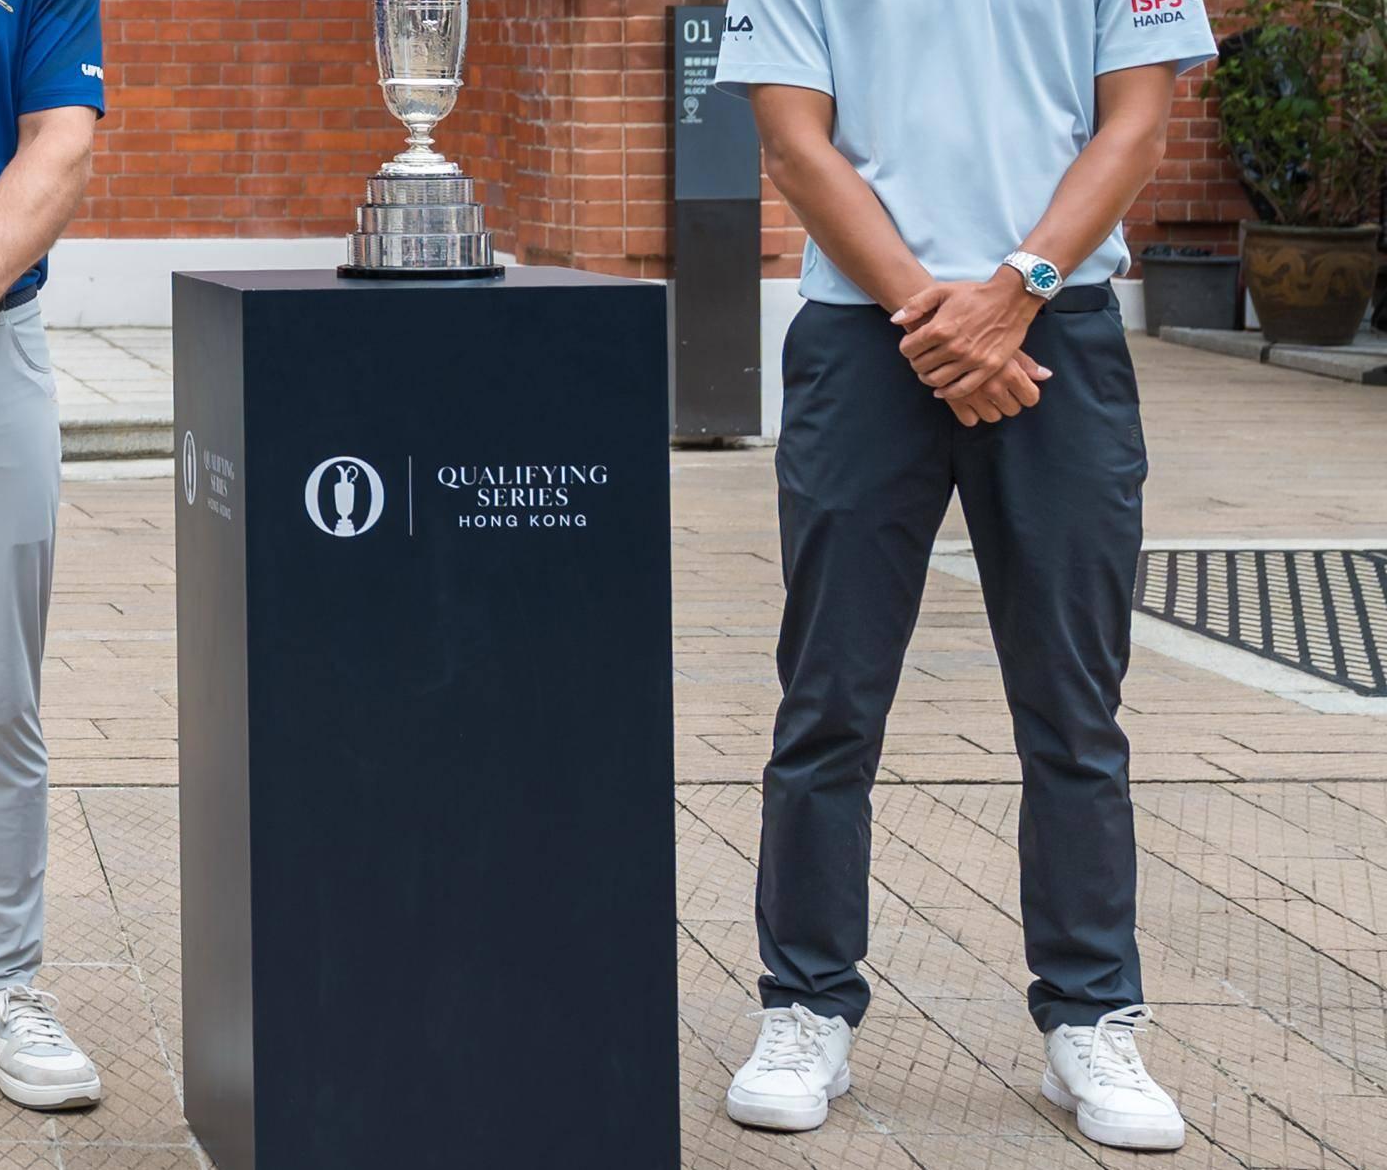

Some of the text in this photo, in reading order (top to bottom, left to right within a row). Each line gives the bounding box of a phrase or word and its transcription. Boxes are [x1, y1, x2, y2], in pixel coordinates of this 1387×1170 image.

[1133, 10, 1186, 28] HANDA
[683, 19, 713, 44] 01
[437, 465, 608, 489] QUALIFYING
[477, 488, 569, 507] SERIES
[459, 514, 587, 528] HONG KONG
